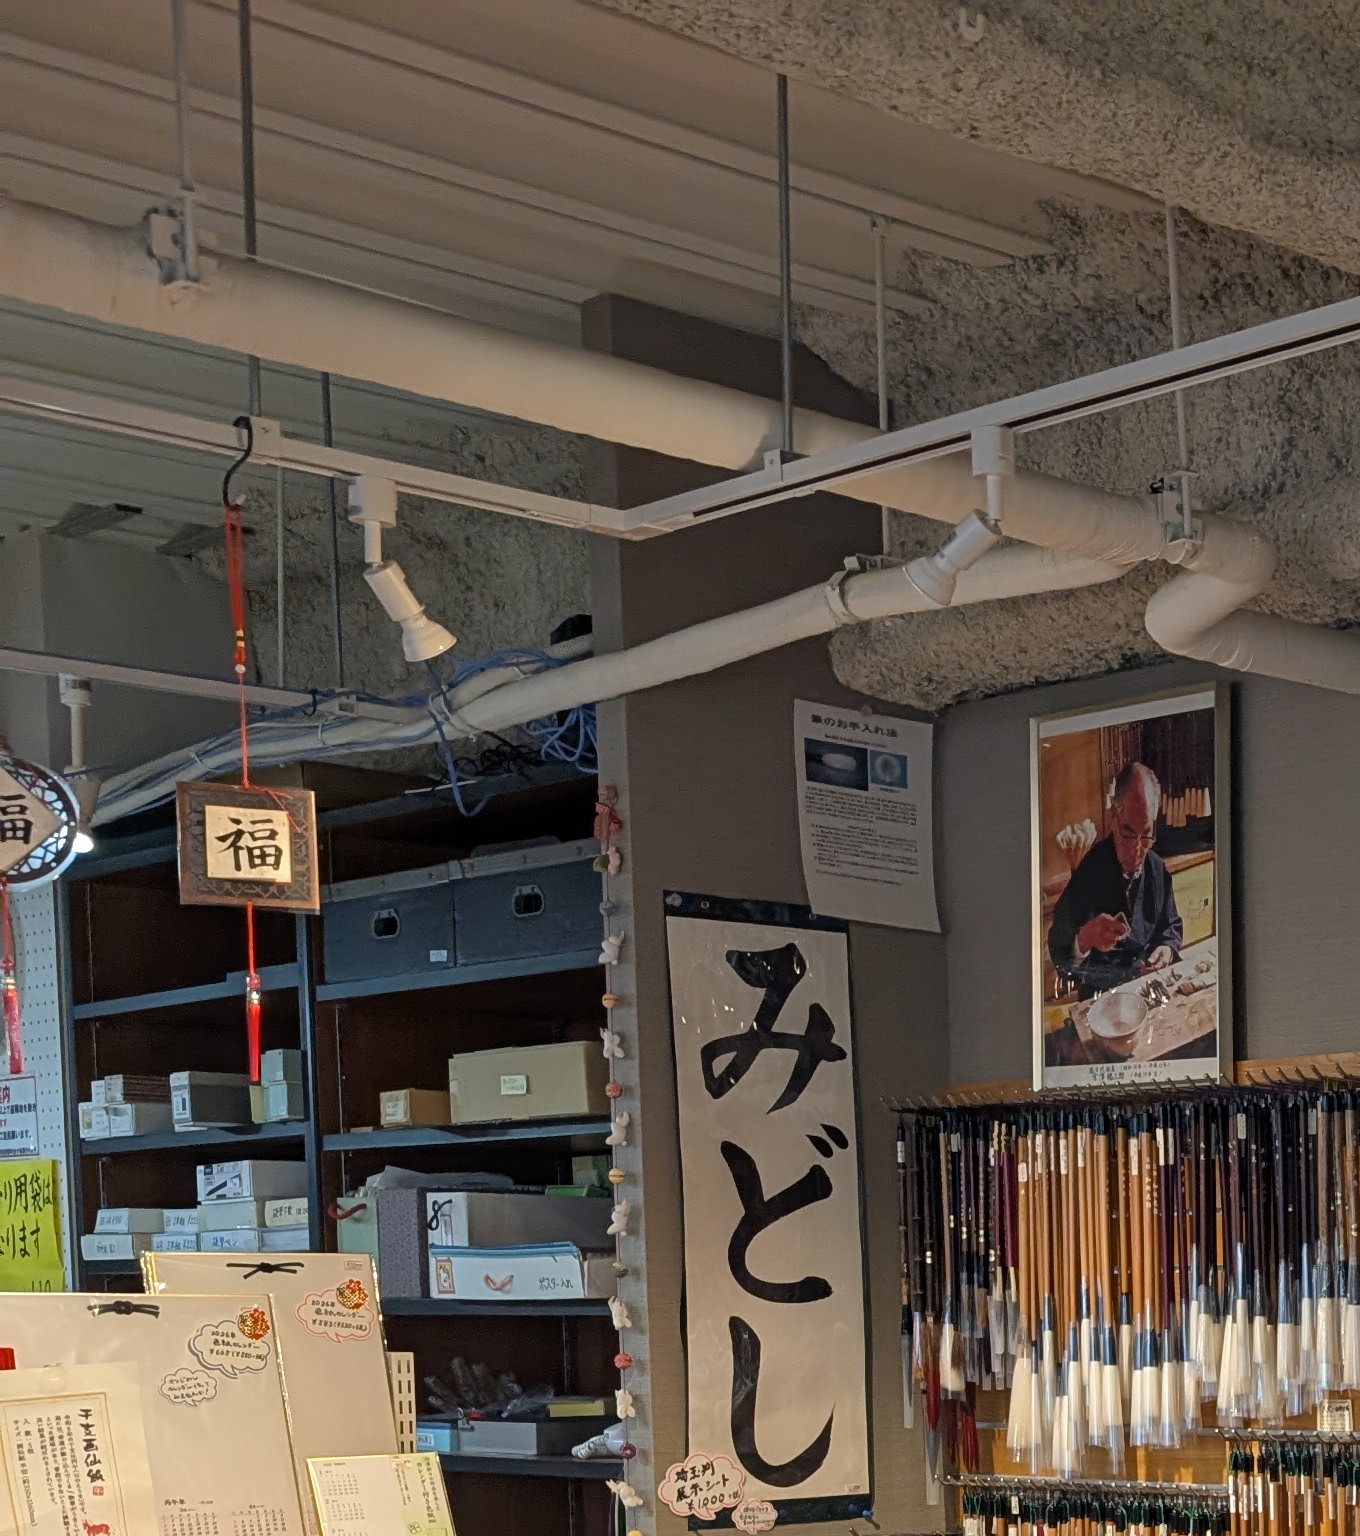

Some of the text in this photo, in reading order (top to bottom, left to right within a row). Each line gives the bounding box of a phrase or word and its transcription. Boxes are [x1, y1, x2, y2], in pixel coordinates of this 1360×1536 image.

[811, 714, 898, 739] 筆のお手入れ法
[214, 817, 285, 872] 福
[702, 941, 848, 1487] みどし
